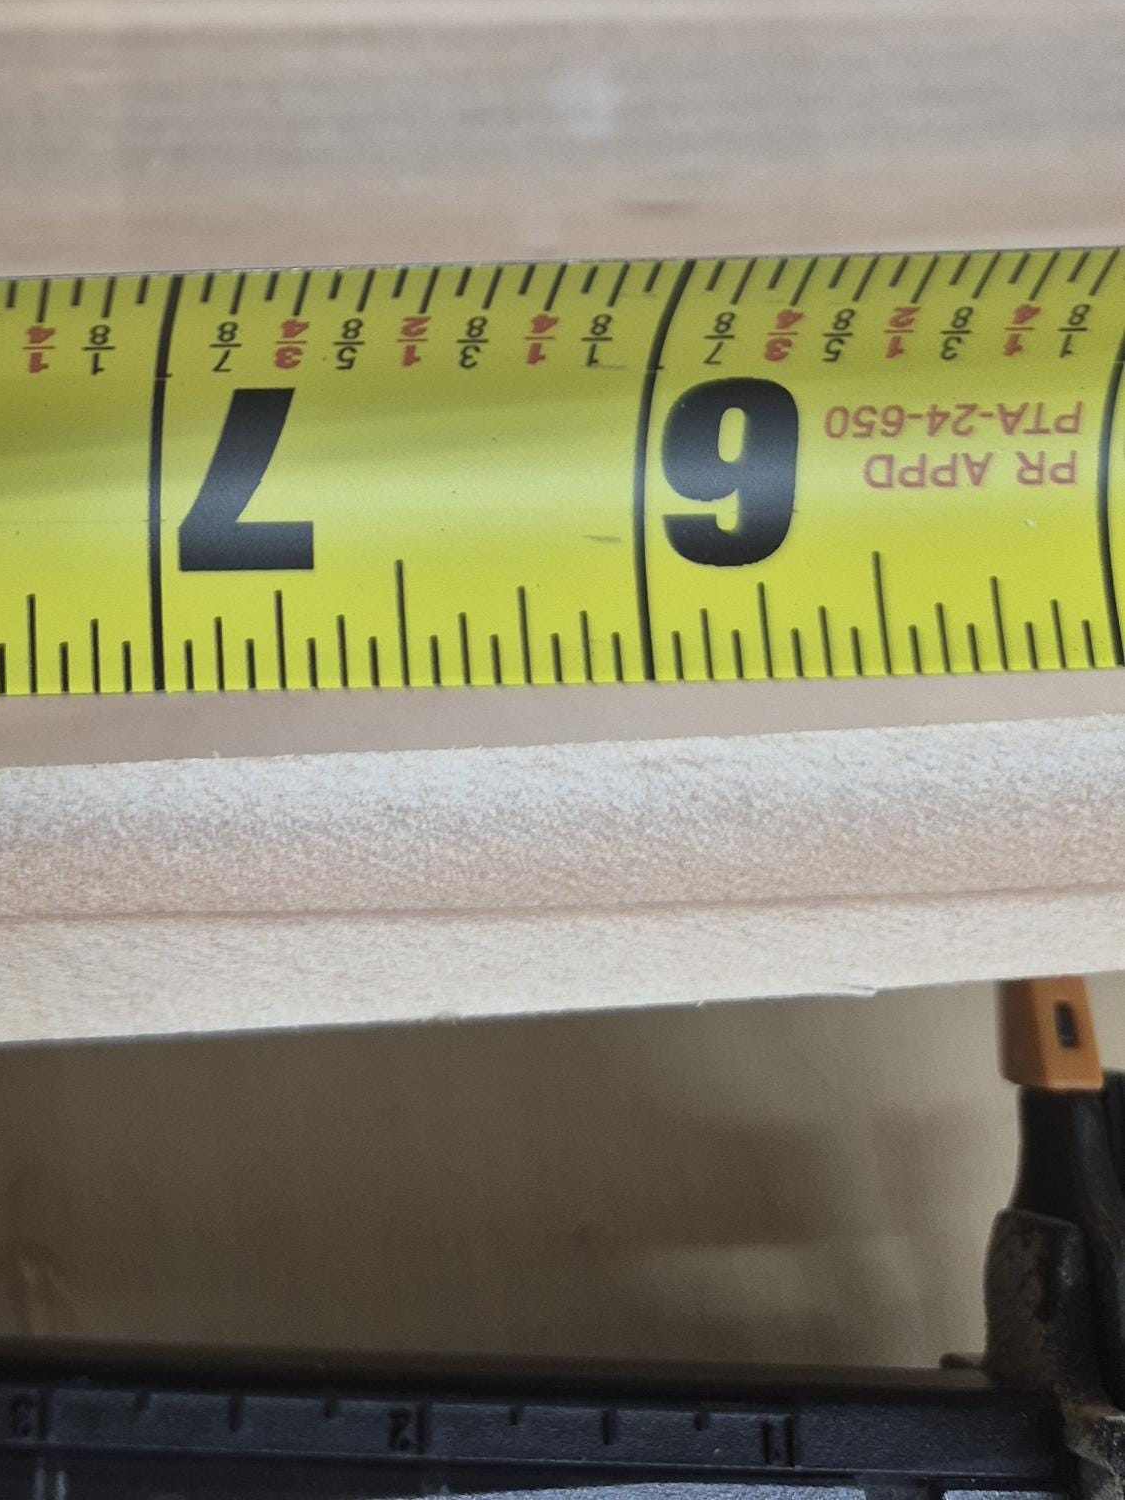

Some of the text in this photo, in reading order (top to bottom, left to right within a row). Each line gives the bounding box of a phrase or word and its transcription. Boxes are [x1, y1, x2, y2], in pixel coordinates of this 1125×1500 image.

[661, 376, 799, 567] 6
[824, 401, 1084, 439] PTA-24-650
[863, 449, 1078, 490] PR APPD
[179, 387, 314, 571] 7
